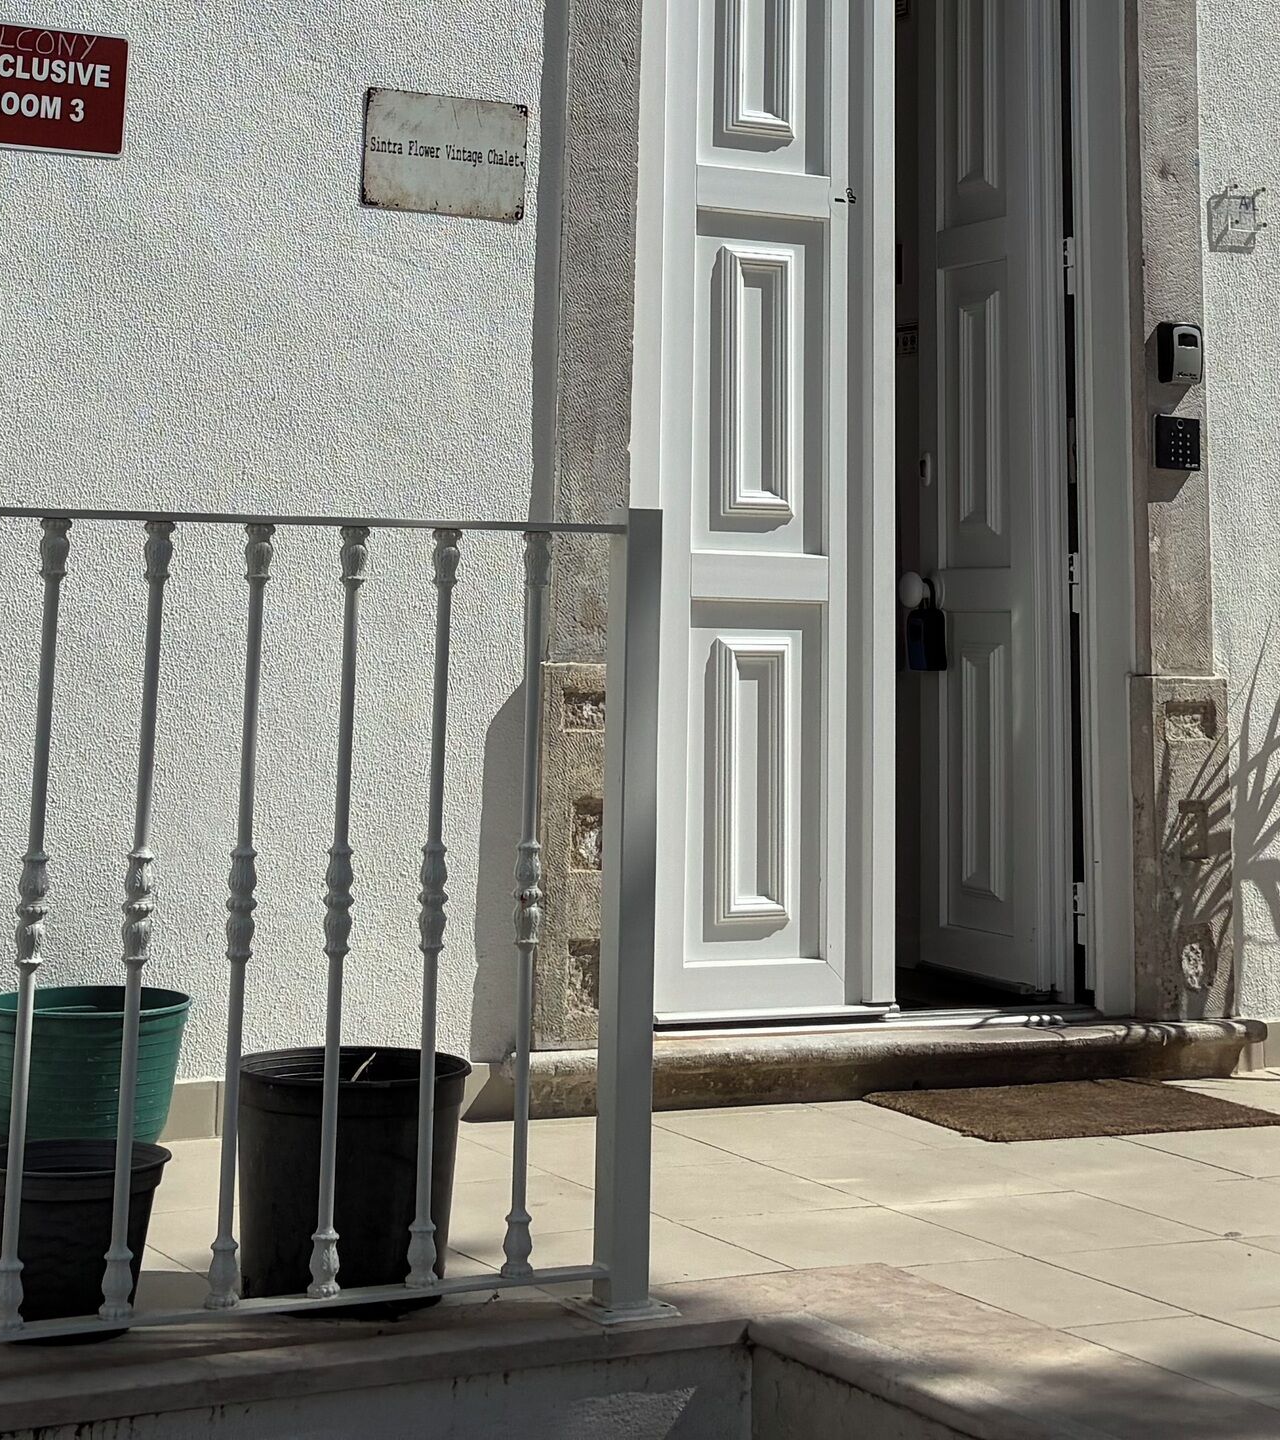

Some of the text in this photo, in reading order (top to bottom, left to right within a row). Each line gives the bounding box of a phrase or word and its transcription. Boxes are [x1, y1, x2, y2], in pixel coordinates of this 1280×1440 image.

[69, 98, 85, 123] 3
[370, 136, 520, 168] Sintra Flower Vintage Chalet
